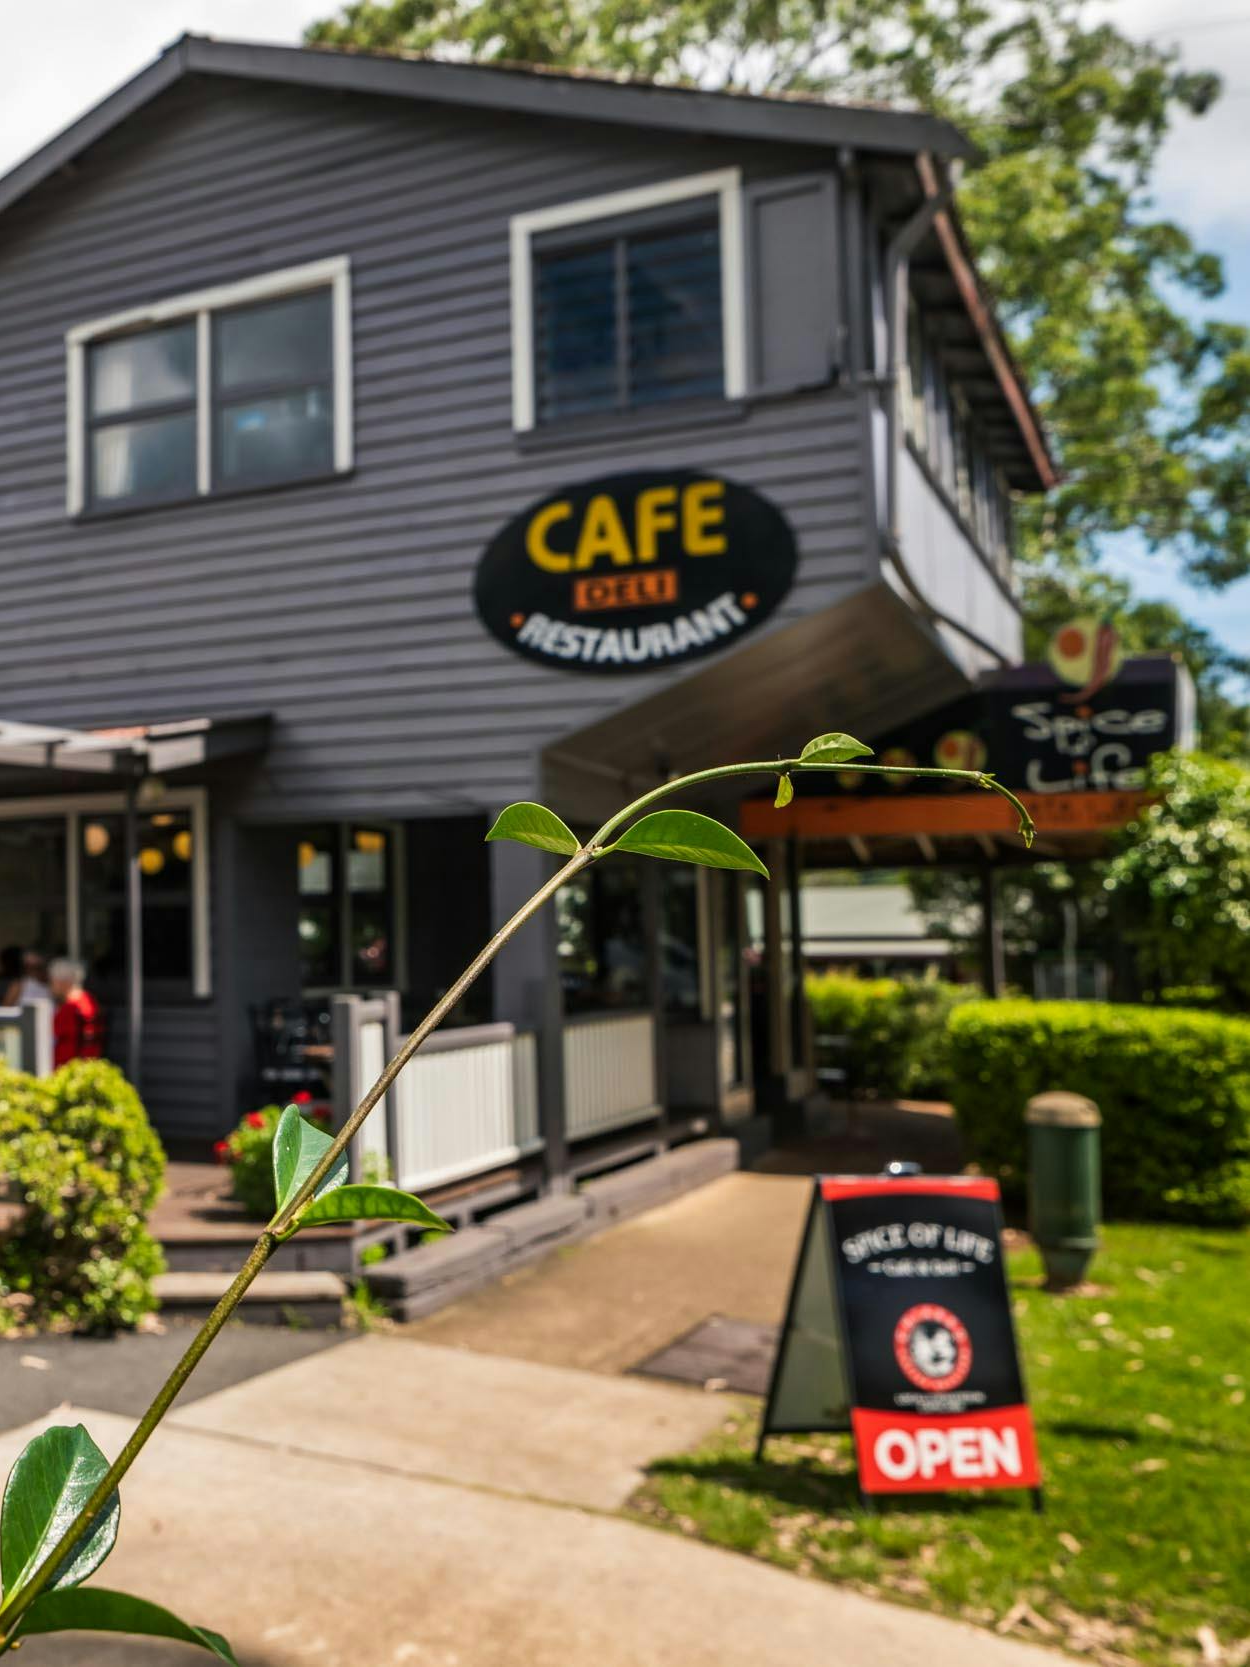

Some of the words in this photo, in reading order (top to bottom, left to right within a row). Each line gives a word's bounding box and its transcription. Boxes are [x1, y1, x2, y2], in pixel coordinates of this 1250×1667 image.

[526, 480, 727, 572] CAFE
[586, 577, 667, 603] DELI
[517, 592, 747, 664] RESTAURANT
[1011, 702, 1168, 755] Spice
[842, 1223, 908, 1264] SPICE
[907, 1222, 943, 1248] OF
[943, 1224, 995, 1264] LIFE
[874, 1427, 1022, 1480] OPEN
